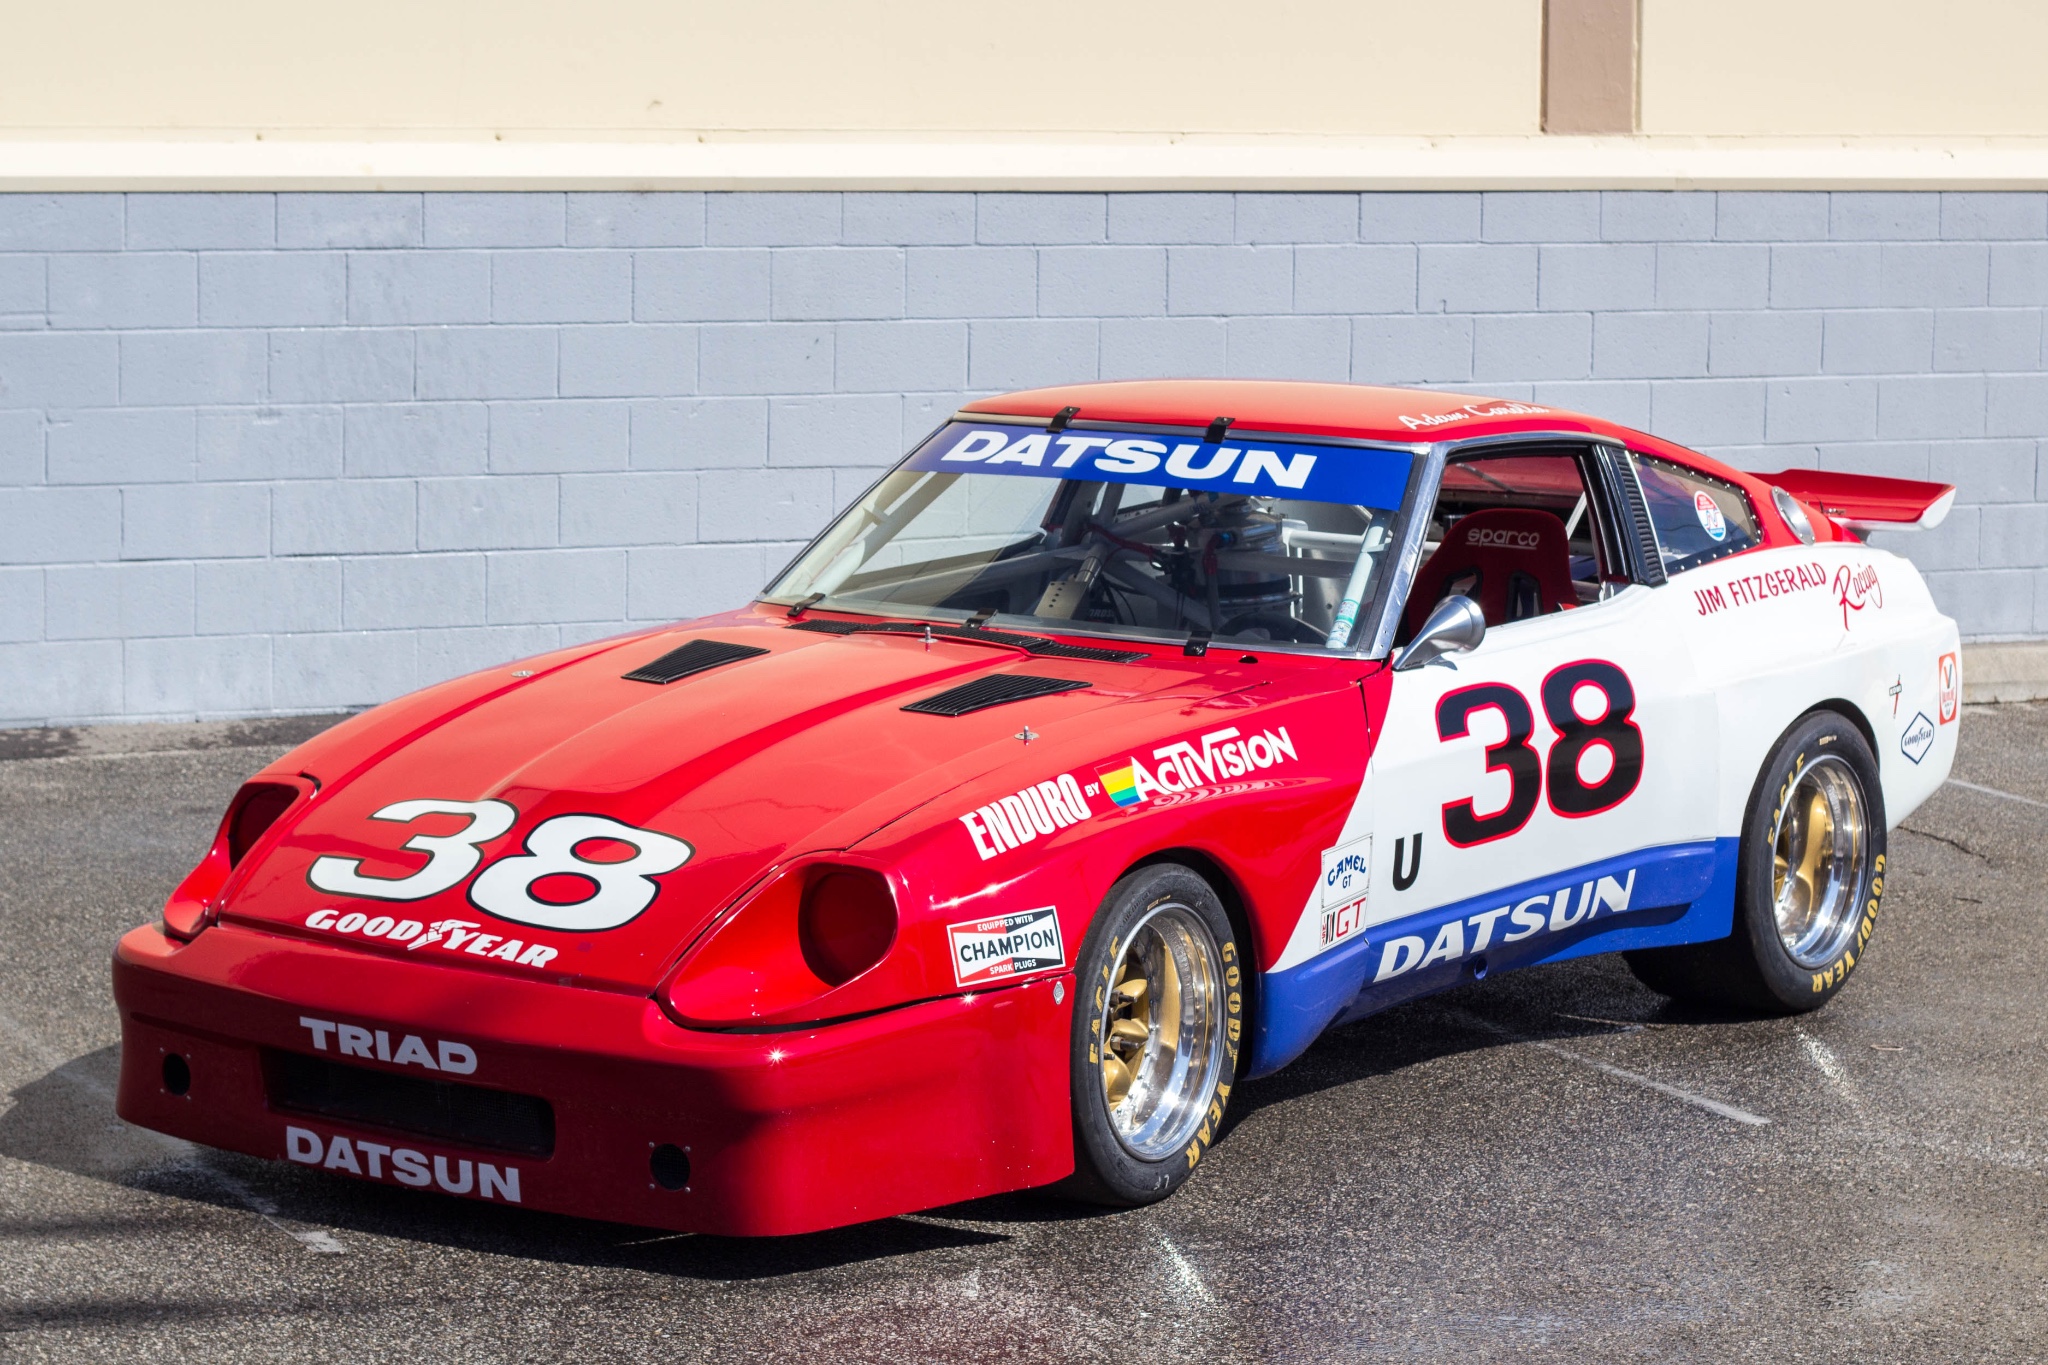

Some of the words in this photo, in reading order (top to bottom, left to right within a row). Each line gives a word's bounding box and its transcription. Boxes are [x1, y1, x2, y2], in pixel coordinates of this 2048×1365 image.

[1398, 411, 1469, 430] Adam
[941, 430, 1317, 490] DATSUN
[1467, 528, 1540, 547] sparco
[1694, 585, 1728, 616] JIM
[1727, 562, 1827, 607] FITZGERALD
[1832, 563, 1883, 631] Racing
[1434, 658, 1645, 848] 38
[959, 773, 1092, 861] ENDURO
[1085, 781, 1100, 797] BY
[306, 799, 695, 932] 38
[1328, 855, 1366, 886] CAMEL
[1342, 874, 1352, 889] GT
[1392, 832, 1423, 891] U
[304, 908, 558, 968] GOODYEAR
[960, 928, 1055, 962] CHAMPION
[977, 918, 1014, 932] EQUIPPED
[1014, 914, 1033, 925] WITH
[1336, 897, 1366, 937] GT
[1373, 869, 1636, 983] DATSUN
[989, 963, 1013, 974] SPARK
[1014, 959, 1036, 970] PLUGS
[300, 1017, 477, 1075] TRIAD
[286, 1126, 521, 1203] DATSUN
